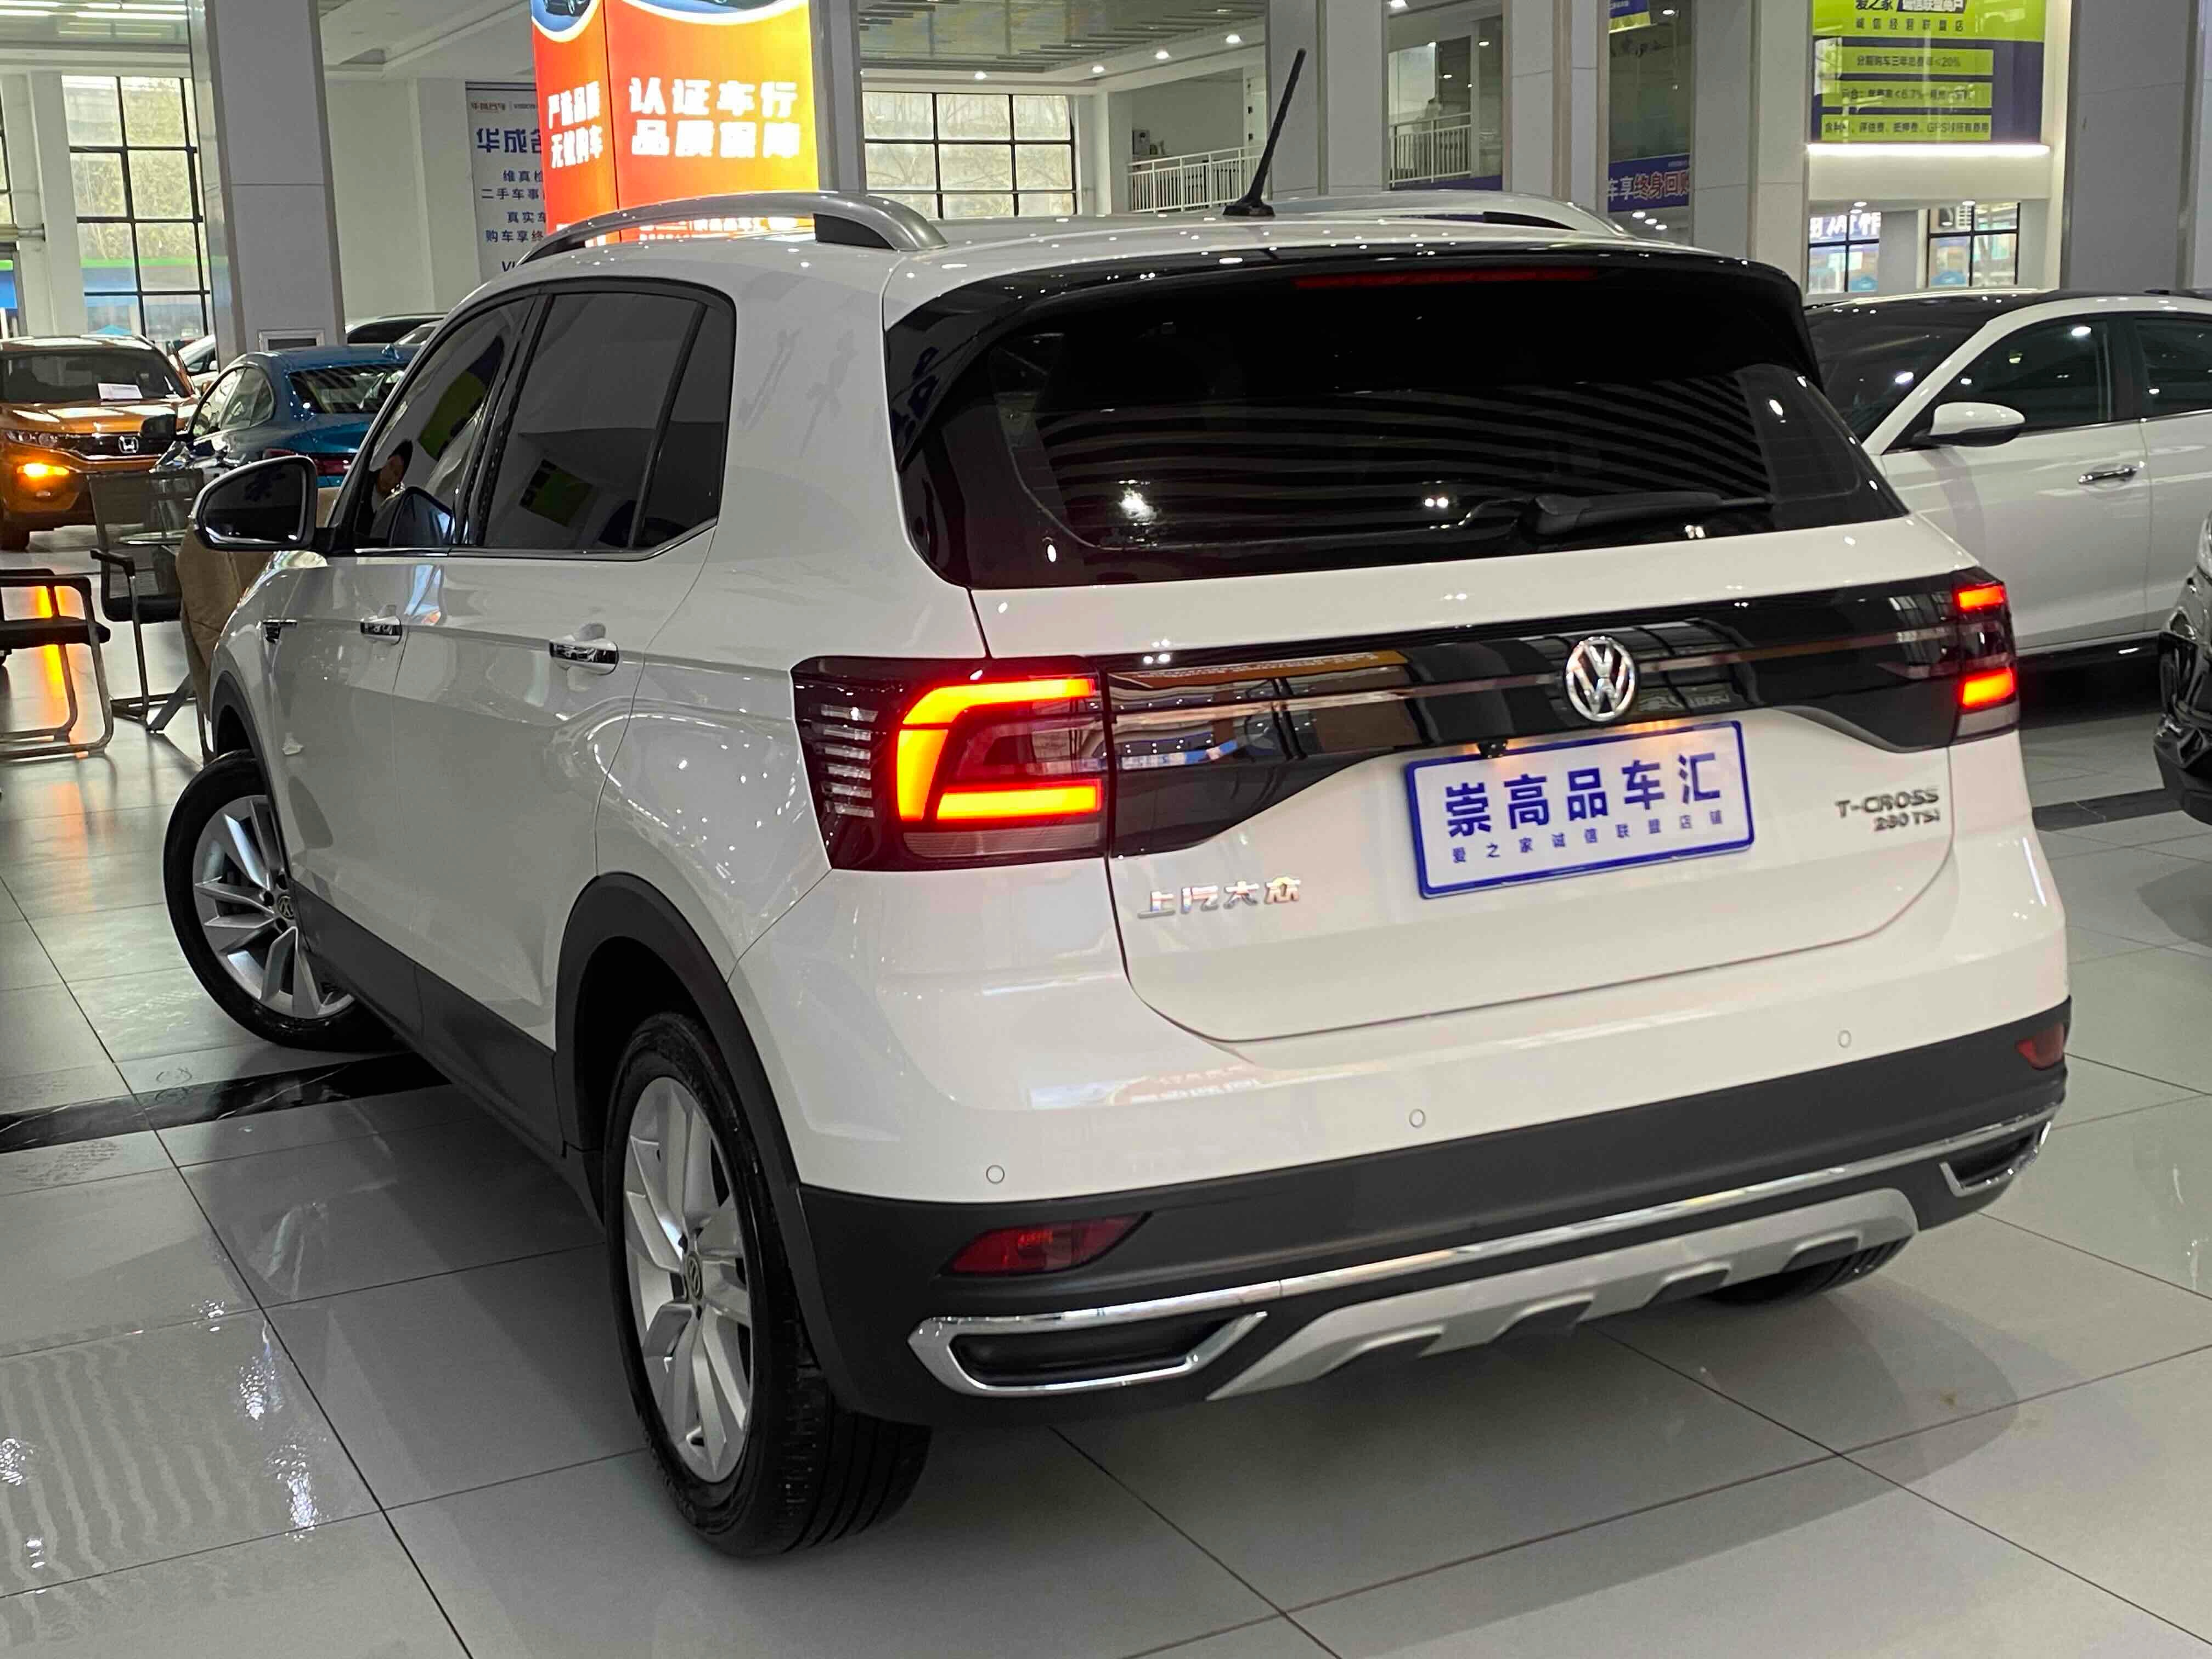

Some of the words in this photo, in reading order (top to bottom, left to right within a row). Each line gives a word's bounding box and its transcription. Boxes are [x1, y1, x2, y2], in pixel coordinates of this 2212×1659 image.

[629, 77, 798, 117] 认证车行
[481, 188, 545, 200] 二手车事
[1444, 752, 1722, 838] 崇高品车汇
[1835, 786, 1939, 819] T-CROSS
[1137, 876, 1302, 919] 上汽大众
